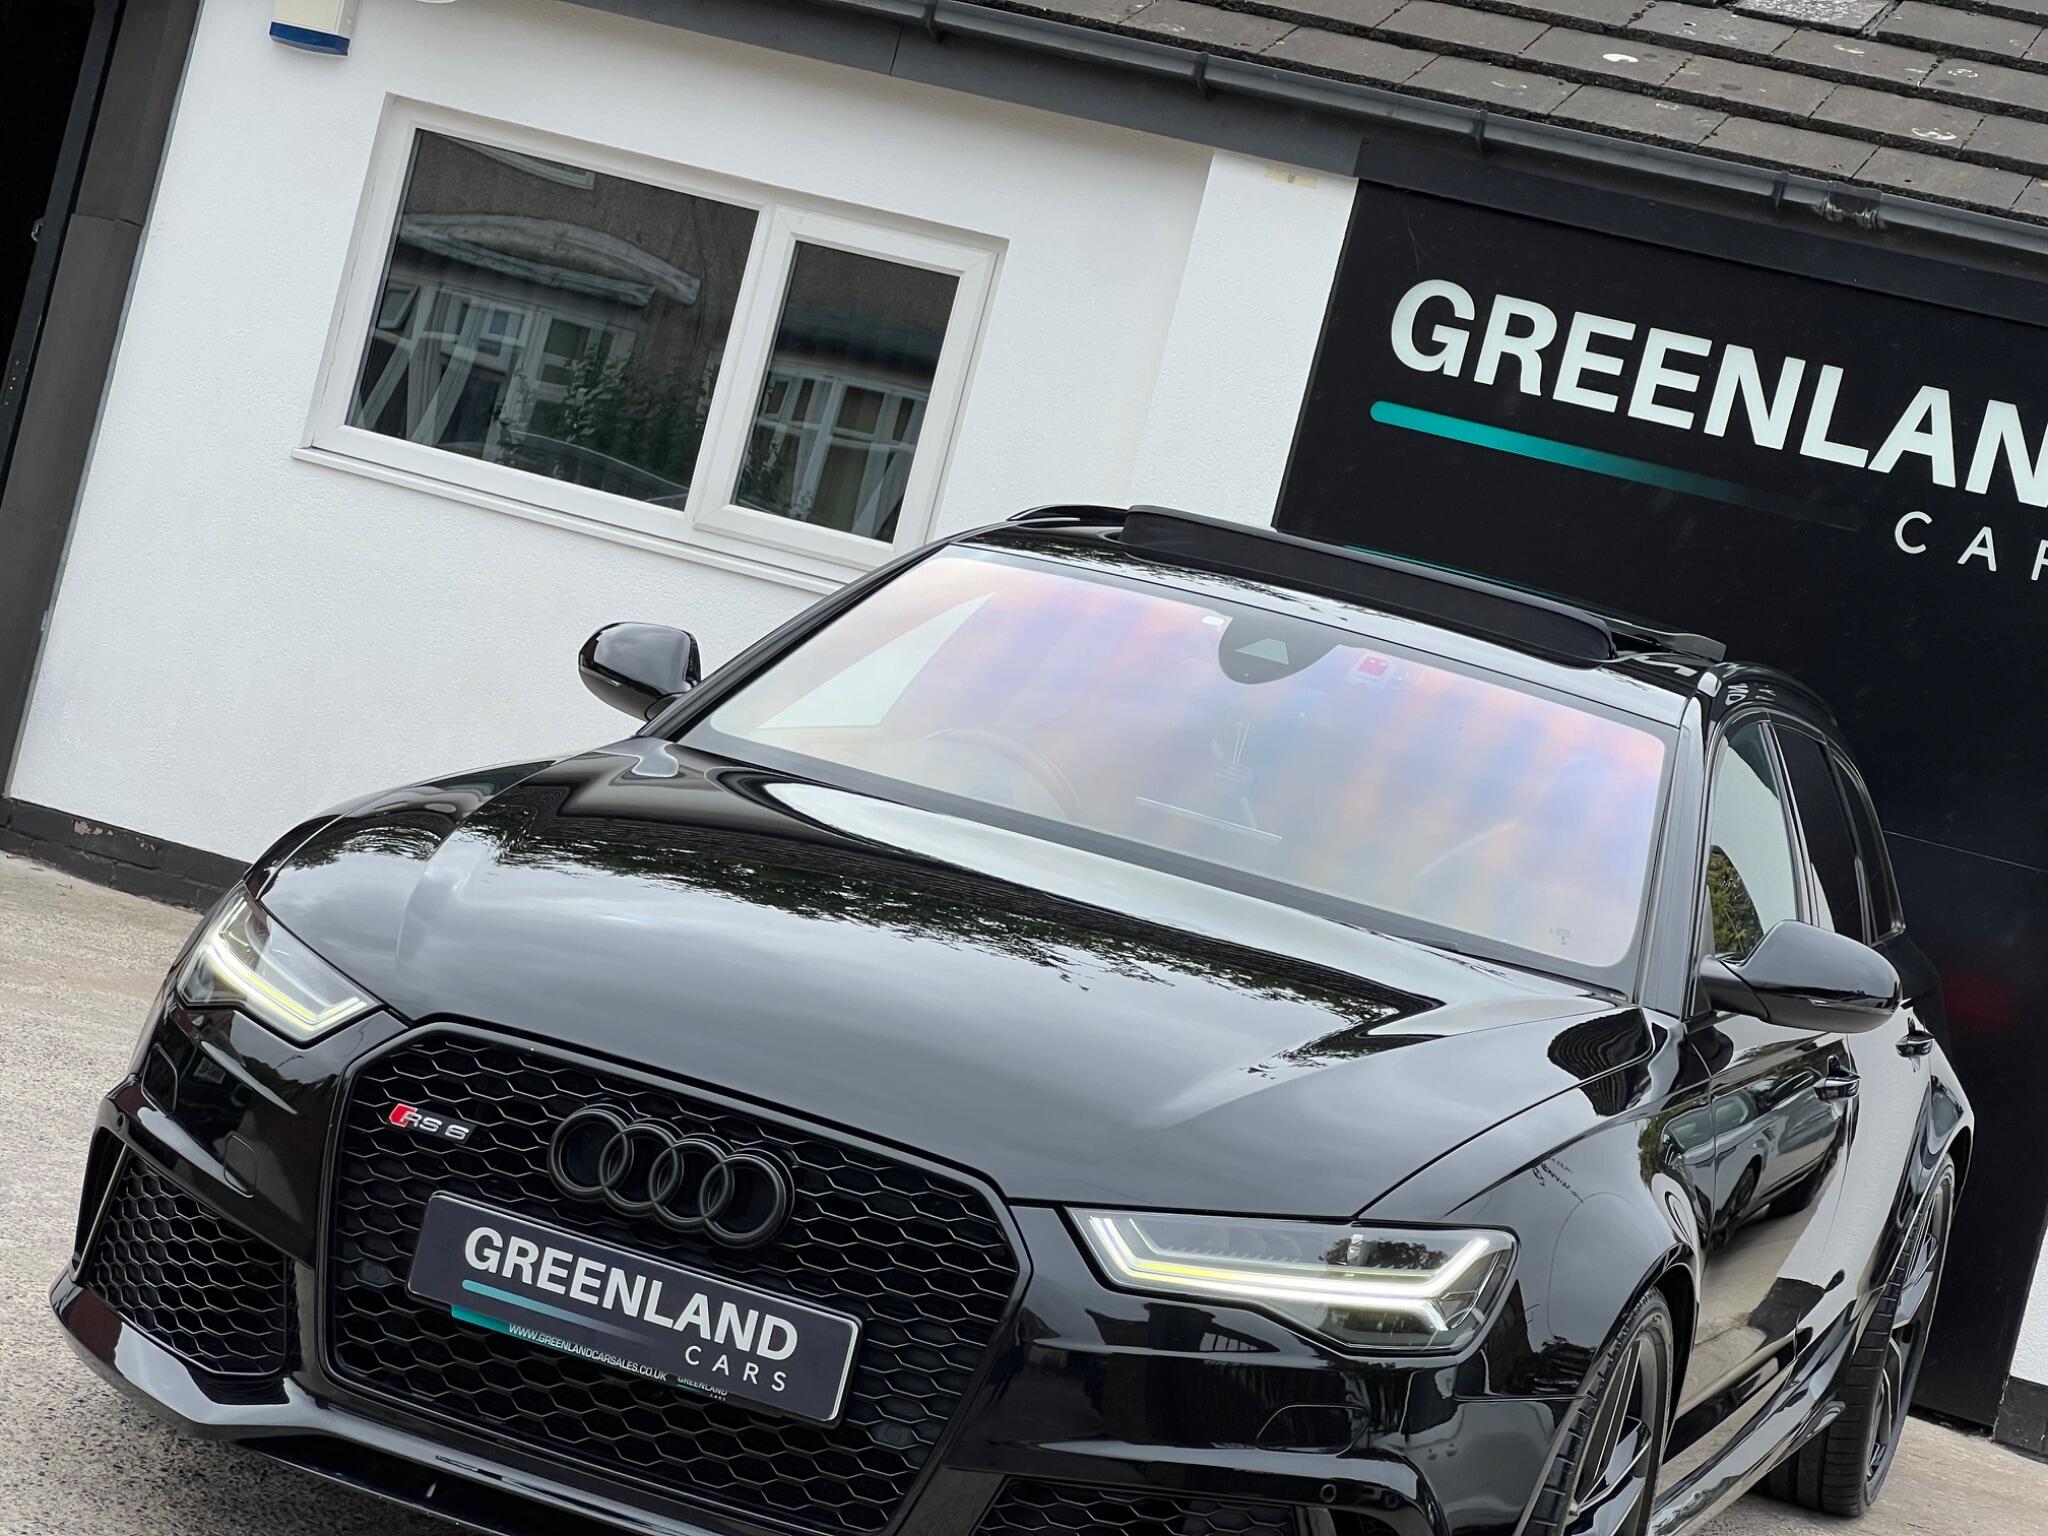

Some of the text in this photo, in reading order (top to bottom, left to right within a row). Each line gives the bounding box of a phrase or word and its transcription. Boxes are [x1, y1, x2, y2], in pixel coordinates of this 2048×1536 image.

[463, 1226, 798, 1361] GREENLAND
[508, 1322, 668, 1382] WWW.GREENLANDCARSALES.CO.UK
[685, 1345, 787, 1392] CARS
